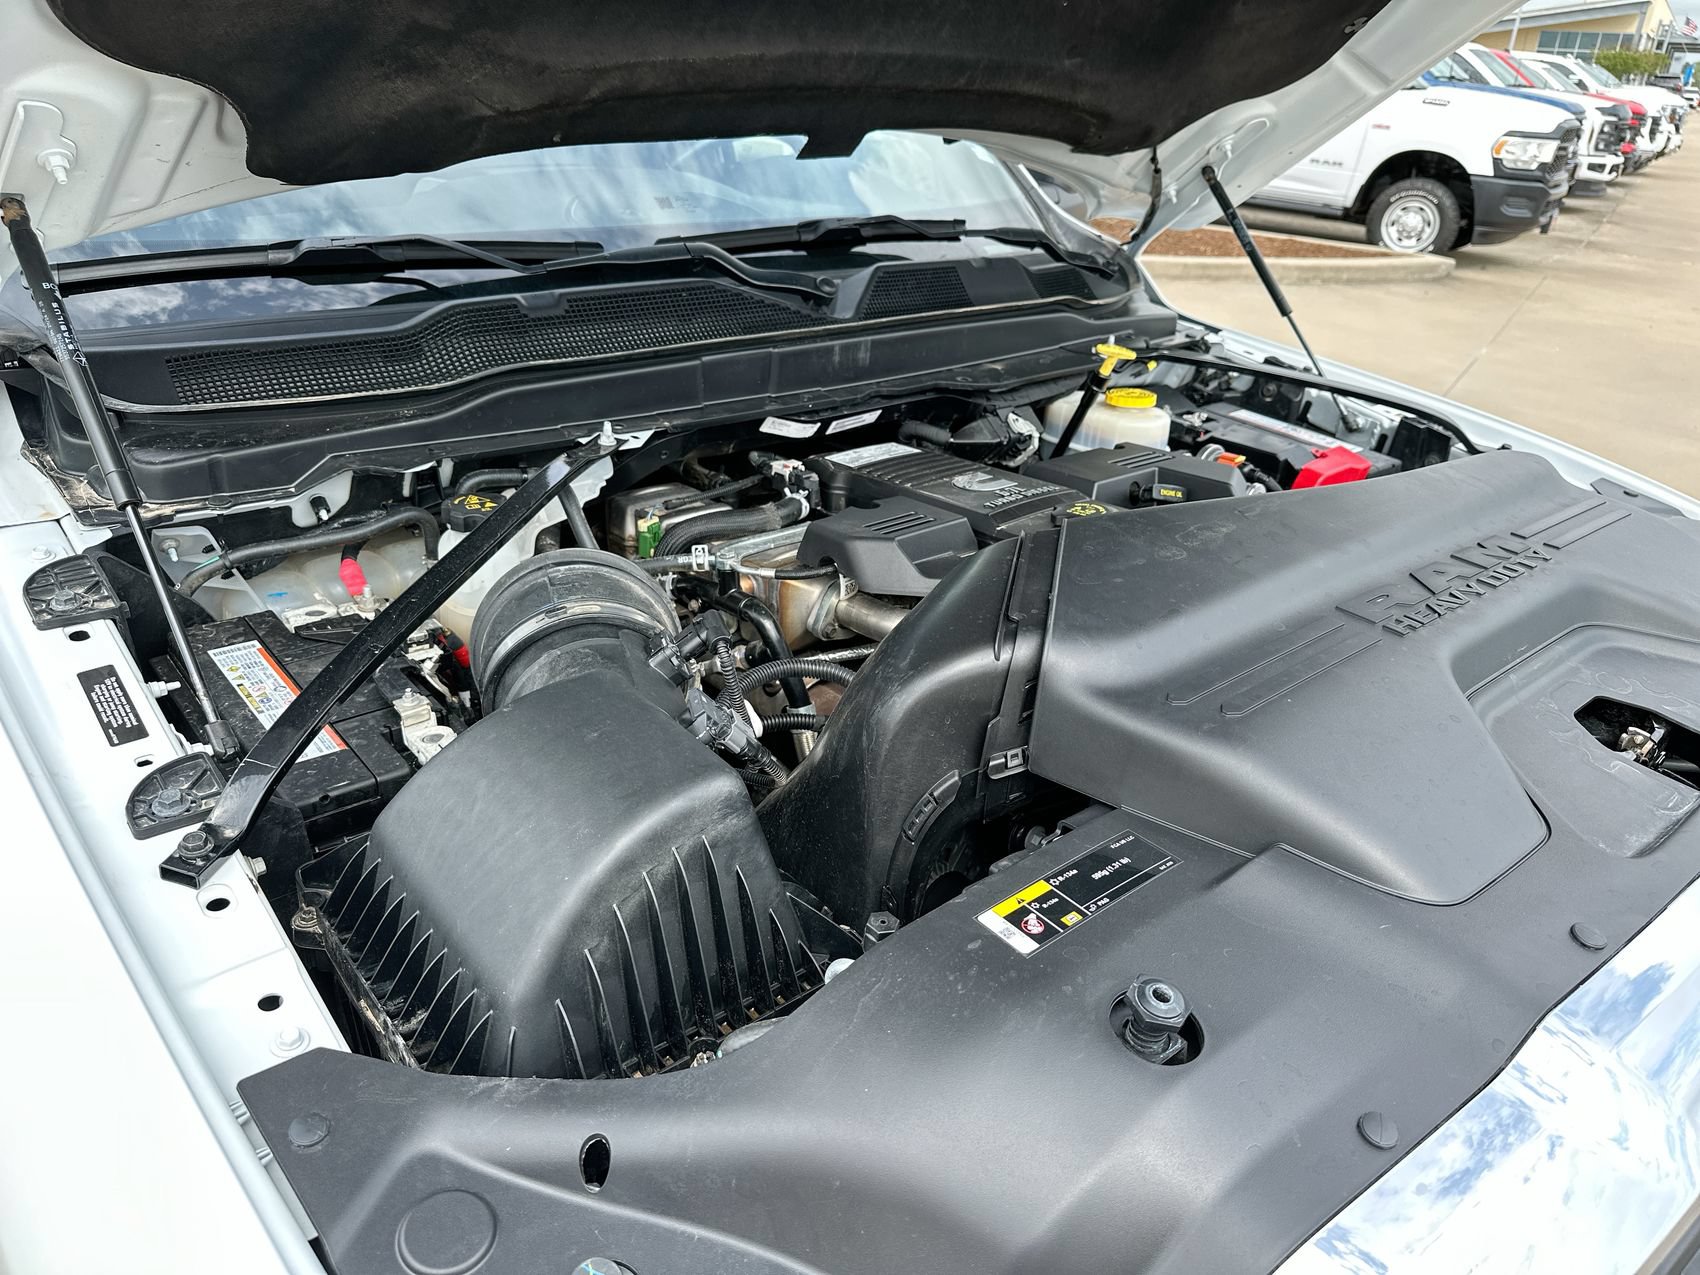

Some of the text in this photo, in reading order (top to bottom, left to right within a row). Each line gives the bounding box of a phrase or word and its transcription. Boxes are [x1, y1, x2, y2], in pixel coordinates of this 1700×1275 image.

[51, 302, 75, 350] STABILUS
[1160, 488, 1183, 498] ENGINE OIL
[1335, 534, 1532, 624] RAM
[1382, 544, 1552, 637] HEAVY DUTY
[1057, 869, 1079, 882] R-134a
[1041, 898, 1060, 909] R-134a
[1097, 897, 1110, 907] PAG
